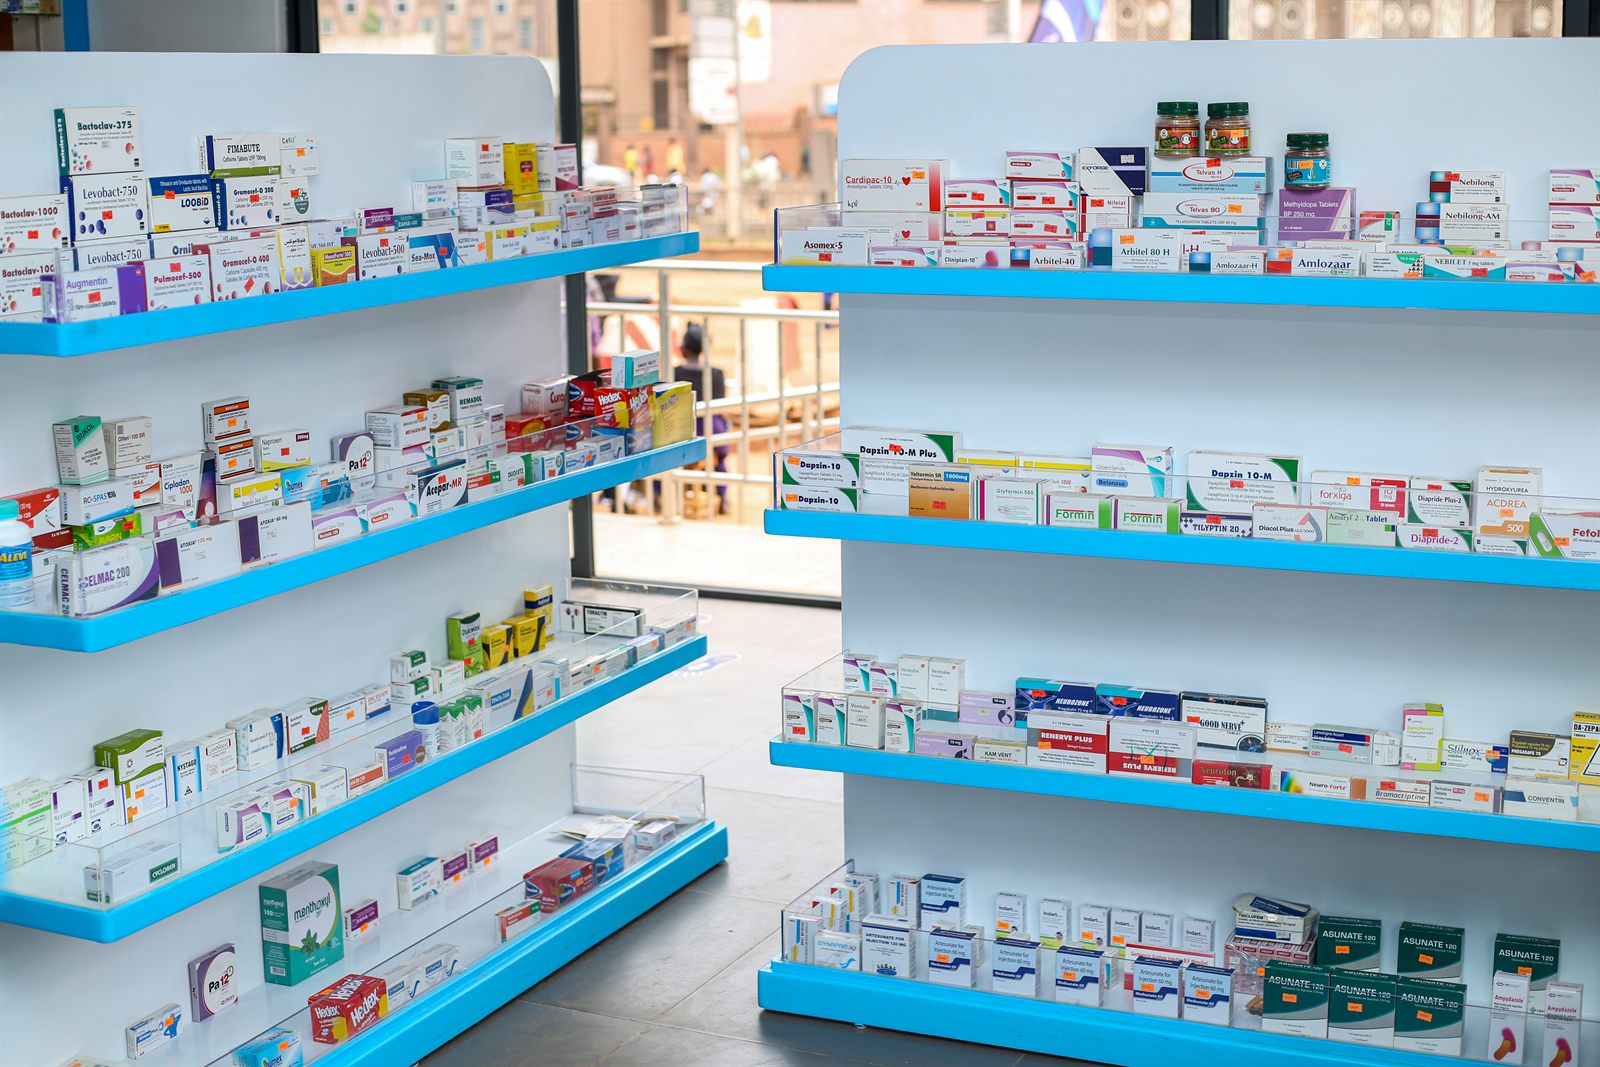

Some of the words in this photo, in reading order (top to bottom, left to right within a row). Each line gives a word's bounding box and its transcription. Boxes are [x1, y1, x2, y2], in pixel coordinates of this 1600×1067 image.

[77, 121, 132, 131] Bactoclav-375
[227, 143, 260, 154] FIMABUTE
[845, 176, 892, 185] Cardipac-10
[1460, 179, 1494, 187] Nebilong
[83, 185, 138, 200] Levobact-750
[1284, 201, 1317, 209] Methyldopa
[1, 206, 58, 219] Bactoclav-1000
[1445, 212, 1500, 220] Nebilong-AM
[804, 240, 843, 250] Asomex-5
[362, 244, 405, 259] Levobact-500
[1120, 248, 1148, 256] Arbitel
[1150, 248, 1162, 256] 80
[1164, 248, 1170, 256] H
[87, 249, 142, 265] Levobact-750
[222, 257, 258, 268] Gramocef-O
[258, 254, 270, 263] 400
[944, 256, 976, 264] Cliniplan-10
[1033, 257, 1075, 266] Arbitel-40
[1216, 261, 1258, 270] Amlozaar-H
[1298, 258, 1352, 269] Amlozaar
[154, 272, 202, 284] Pulmocef-500
[66, 277, 108, 290] Augmentin
[598, 392, 622, 406] Hedex
[76, 424, 94, 442] BUKOL
[860, 446, 889, 456] Dapzin
[919, 448, 937, 458] Plus
[349, 460, 359, 471] Pa
[359, 456, 367, 468] 12
[800, 461, 840, 470] Dapzin-10
[945, 473, 968, 481] 1000mg
[1211, 470, 1243, 480] Dapzin
[1247, 472, 1272, 481] 10-M
[164, 478, 190, 490] Cipladon
[426, 477, 462, 497] Acepar-MR
[180, 486, 192, 494] 1000
[996, 488, 1023, 496] Glyformin
[1320, 490, 1351, 500] forxiga
[83, 493, 107, 504] RO-SPAS
[798, 495, 839, 505] Dapzin-10
[1418, 495, 1443, 504] Diapride
[1487, 499, 1526, 508] ACDREA
[1055, 509, 1094, 520] Formin
[1123, 512, 1163, 524] Formin
[1366, 515, 1388, 523] Tablet
[1193, 524, 1228, 532] TILYPTIN
[1230, 524, 1239, 533] 20
[1411, 534, 1458, 545] Diapride-2
[116, 566, 130, 580] 200
[1055, 698, 1090, 707] NEUROZONE
[1136, 705, 1171, 714] NEUROZONE
[1041, 732, 1072, 741] RENERVE
[1074, 735, 1093, 743] PLUS
[1448, 744, 1480, 756] Stilnox
[1200, 766, 1237, 776] Neuroton
[1376, 791, 1425, 801] Bromocriptine
[1528, 796, 1565, 804] CONVENTIN
[294, 893, 331, 922] menthoxyl
[1322, 931, 1362, 940] ASUNATE
[1403, 936, 1443, 948] ASUNATE
[999, 949, 1023, 957] Artesunate
[1499, 949, 1540, 960] ASUNATE
[1062, 958, 1086, 966] Artesunate
[1140, 968, 1164, 976] Artesunate
[208, 980, 220, 992] Pa
[220, 973, 229, 986] 12
[1192, 976, 1216, 984] Artesunate
[1268, 976, 1310, 988] ASUNATE
[1334, 984, 1376, 996] ASUNATE
[1401, 993, 1444, 1006] ASUNATE
[1495, 995, 1523, 1003] Ampydazole
[315, 1006, 339, 1018] Hedex
[351, 988, 380, 1026] Hedex
[1547, 1006, 1576, 1014] Ampydazole
